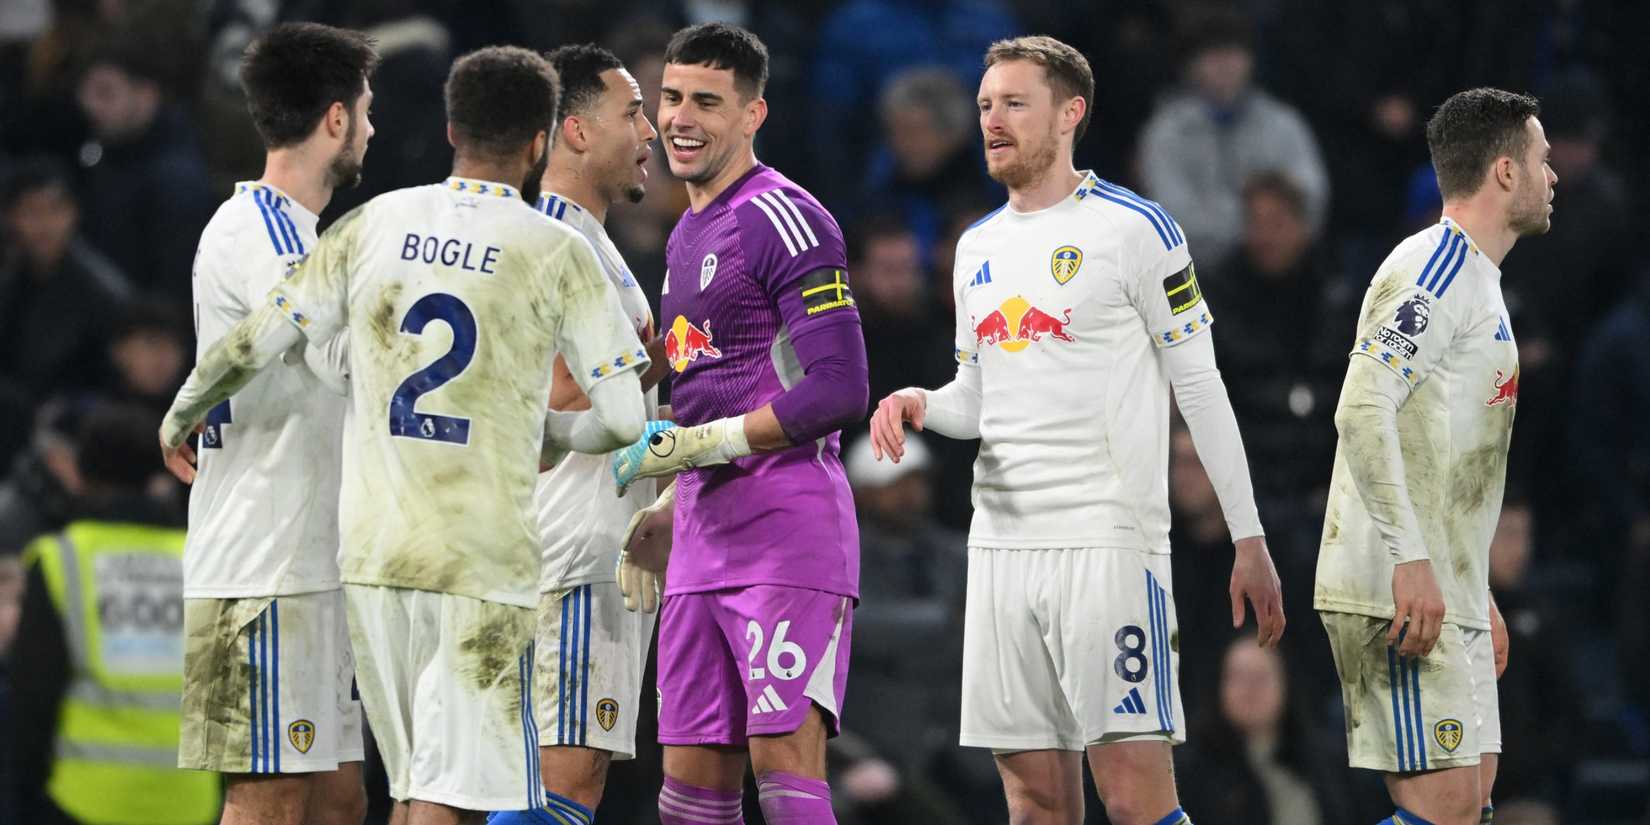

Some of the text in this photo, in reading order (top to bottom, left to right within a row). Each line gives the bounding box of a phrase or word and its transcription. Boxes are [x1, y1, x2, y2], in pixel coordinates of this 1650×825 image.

[401, 233, 501, 274] BOGLE
[389, 292, 478, 446] 2
[1391, 332, 1414, 352] room
[746, 620, 807, 680] 26
[1114, 625, 1148, 683] 8
